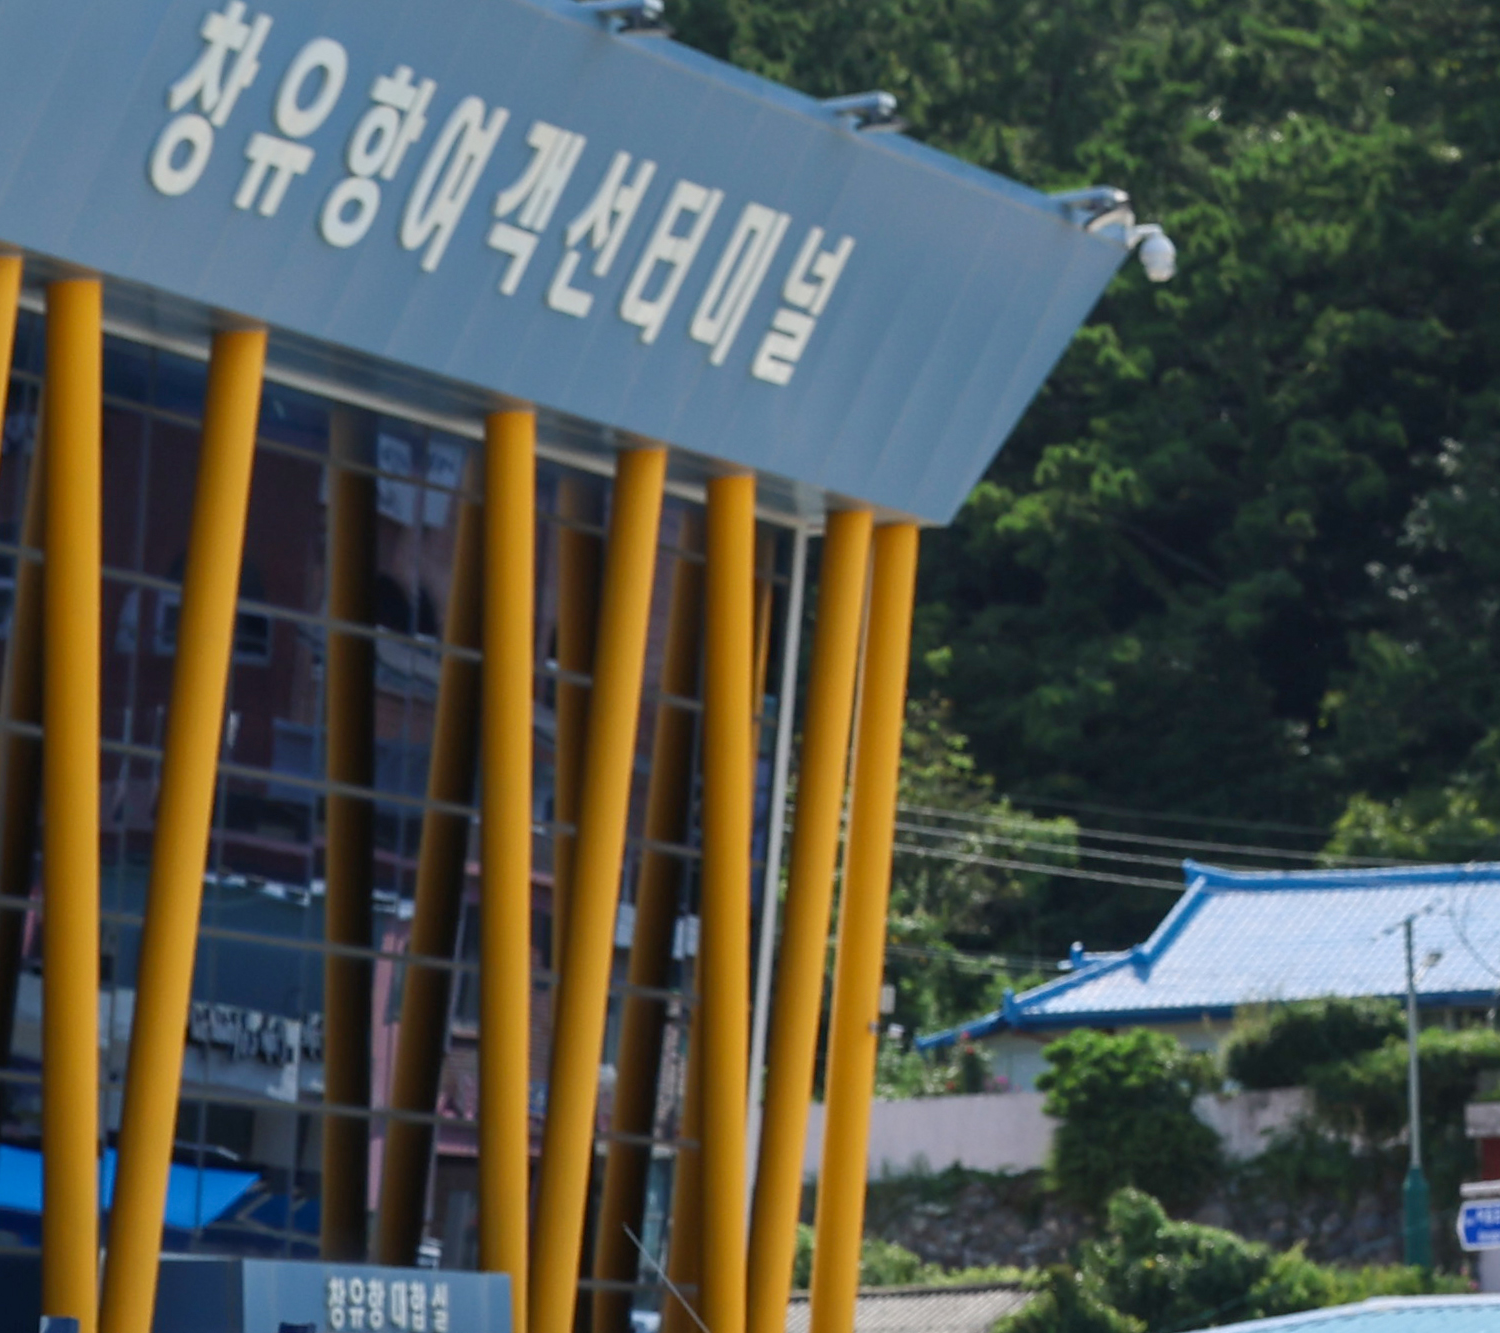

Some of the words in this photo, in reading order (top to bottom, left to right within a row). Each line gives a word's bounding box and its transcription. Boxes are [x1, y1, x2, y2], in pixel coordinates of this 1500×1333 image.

[150, 1, 854, 385] 창유항여객선터미널
[328, 1276, 385, 1331] 창유항
[390, 1280, 449, 1333] 대합실
